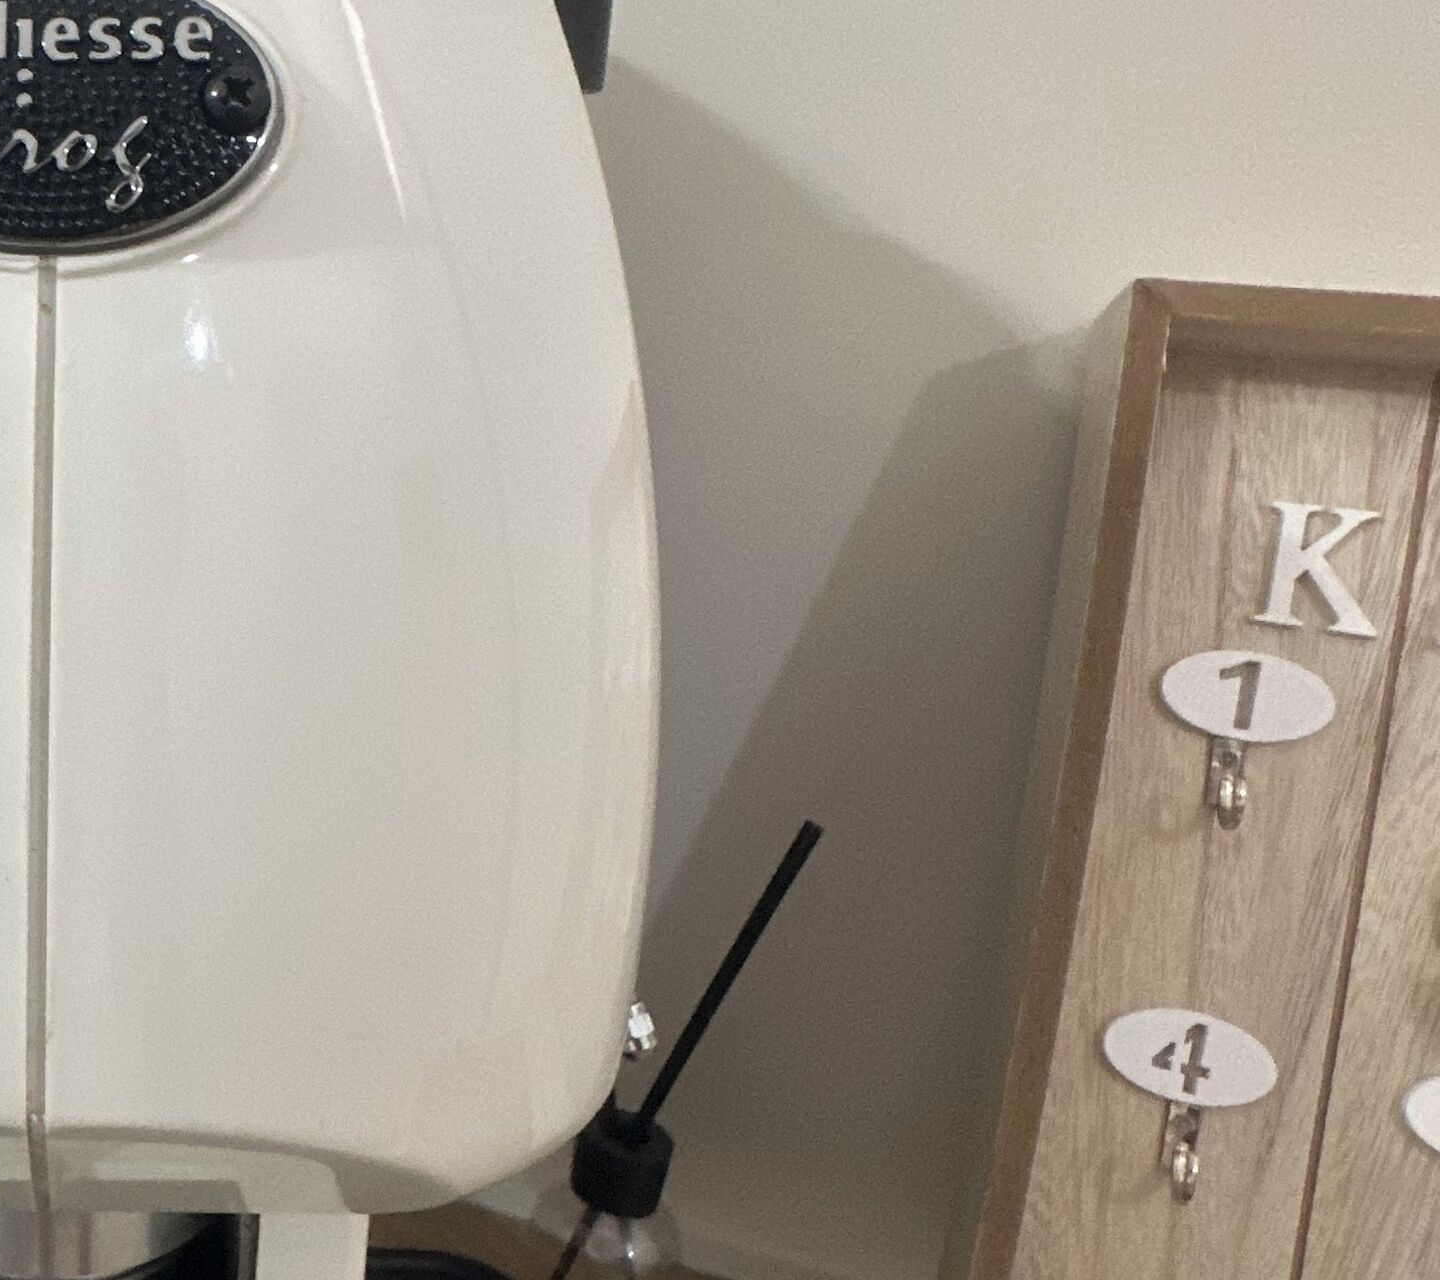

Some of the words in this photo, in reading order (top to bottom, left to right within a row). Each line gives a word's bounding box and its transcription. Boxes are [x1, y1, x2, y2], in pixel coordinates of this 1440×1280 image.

[1253, 501, 1381, 637] K
[1218, 661, 1262, 731] 1
[1150, 1022, 1211, 1095] 4
